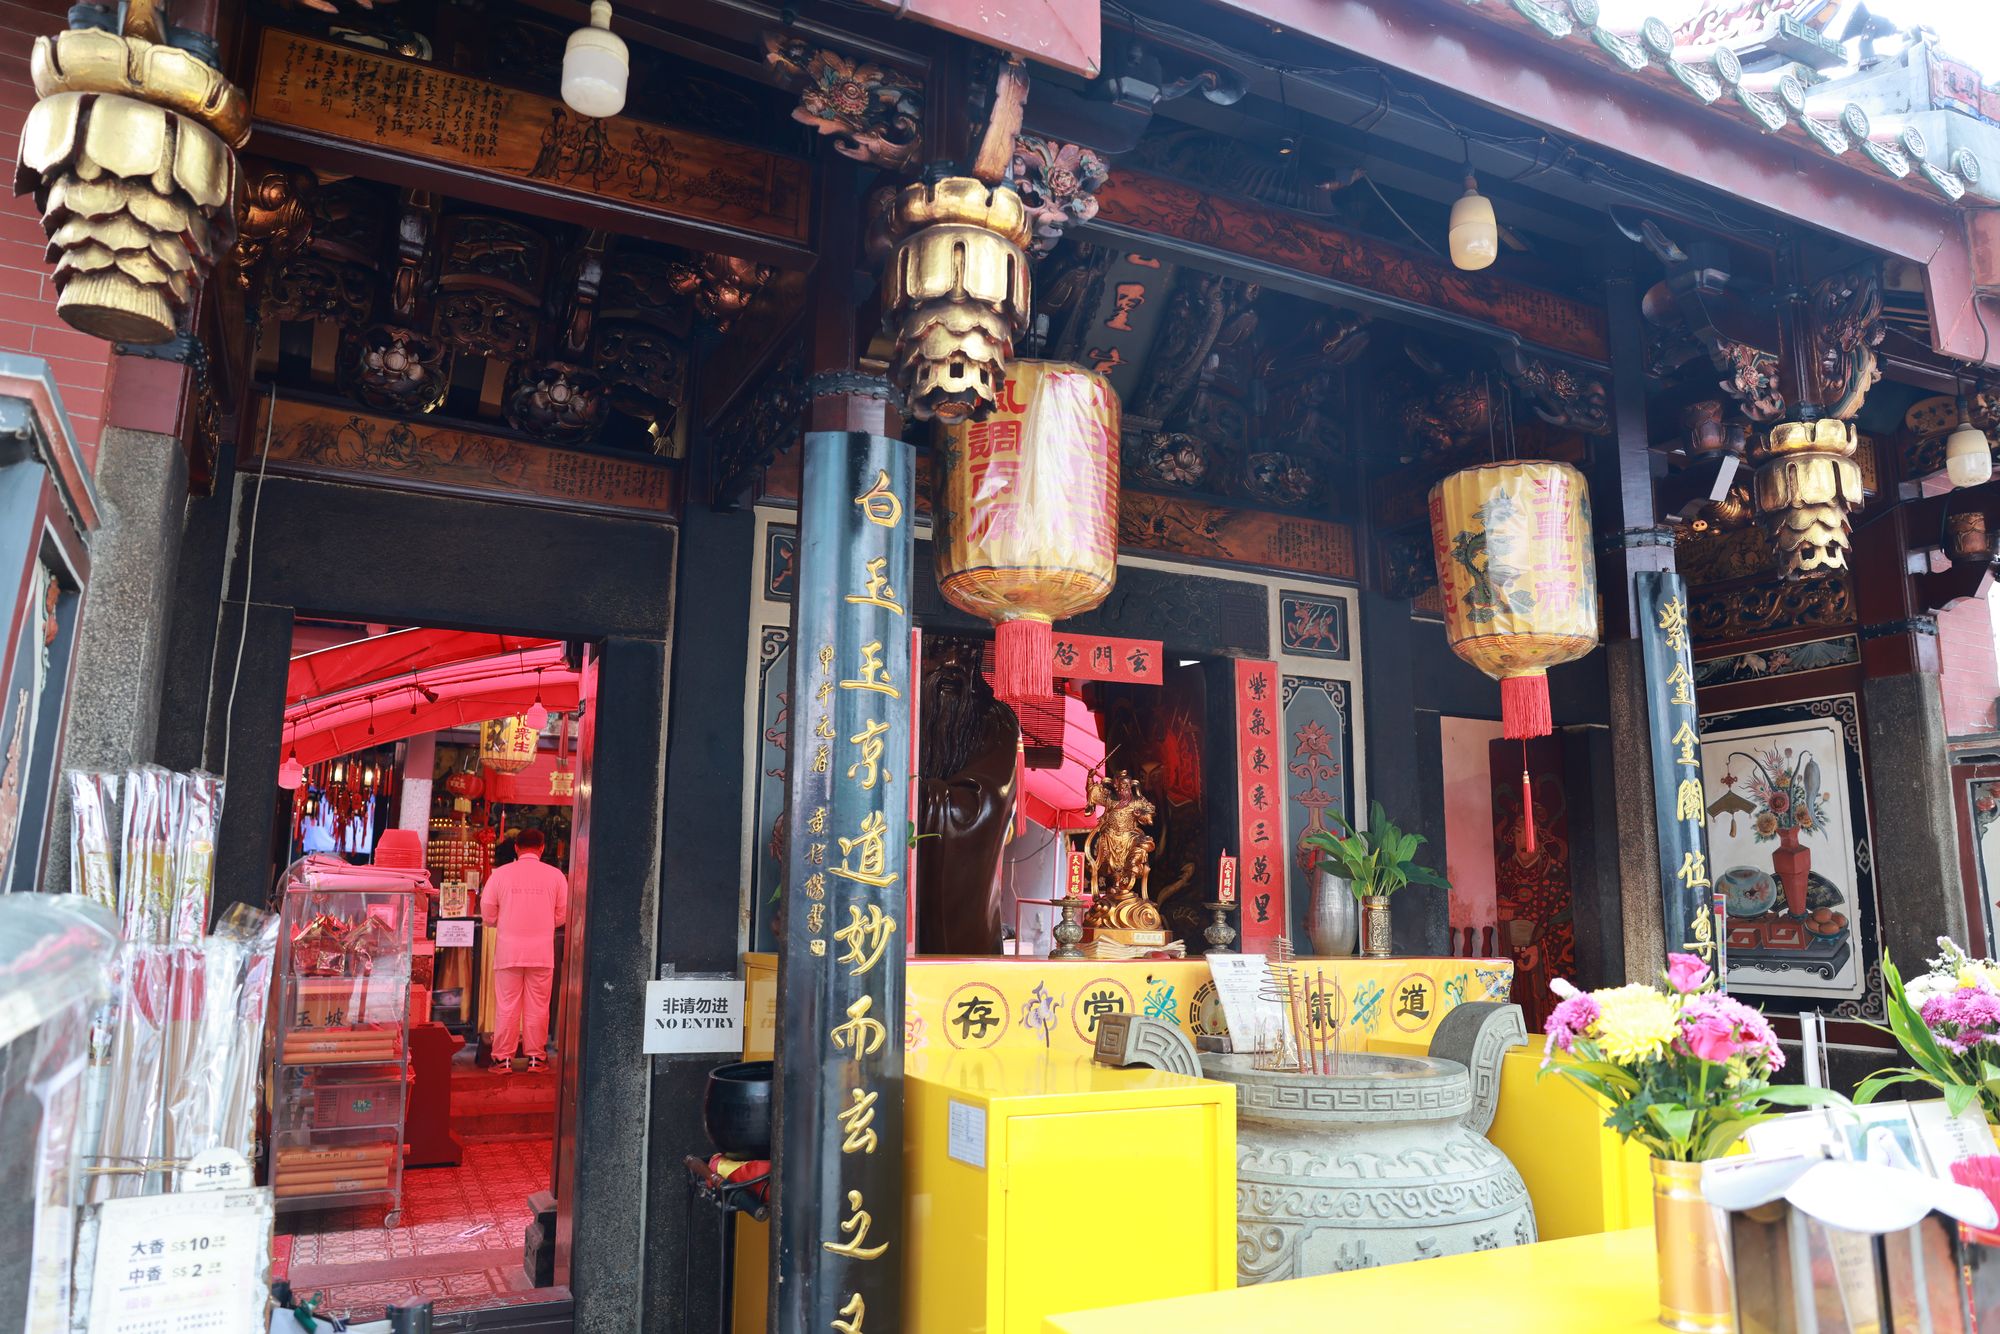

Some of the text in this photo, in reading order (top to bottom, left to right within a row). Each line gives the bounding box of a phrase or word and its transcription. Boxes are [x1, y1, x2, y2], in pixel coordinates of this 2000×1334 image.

[662, 997, 728, 1015] 非请勿进
[1396, 984, 1430, 1020] 道
[655, 1017, 737, 1029] NO ENTRY
[952, 996, 1000, 1039] 存
[204, 1161, 231, 1178] 中香
[131, 1238, 164, 1256] 大香
[190, 1237, 209, 1251] 10
[129, 1265, 161, 1284] 中香
[192, 1263, 202, 1277] 2
